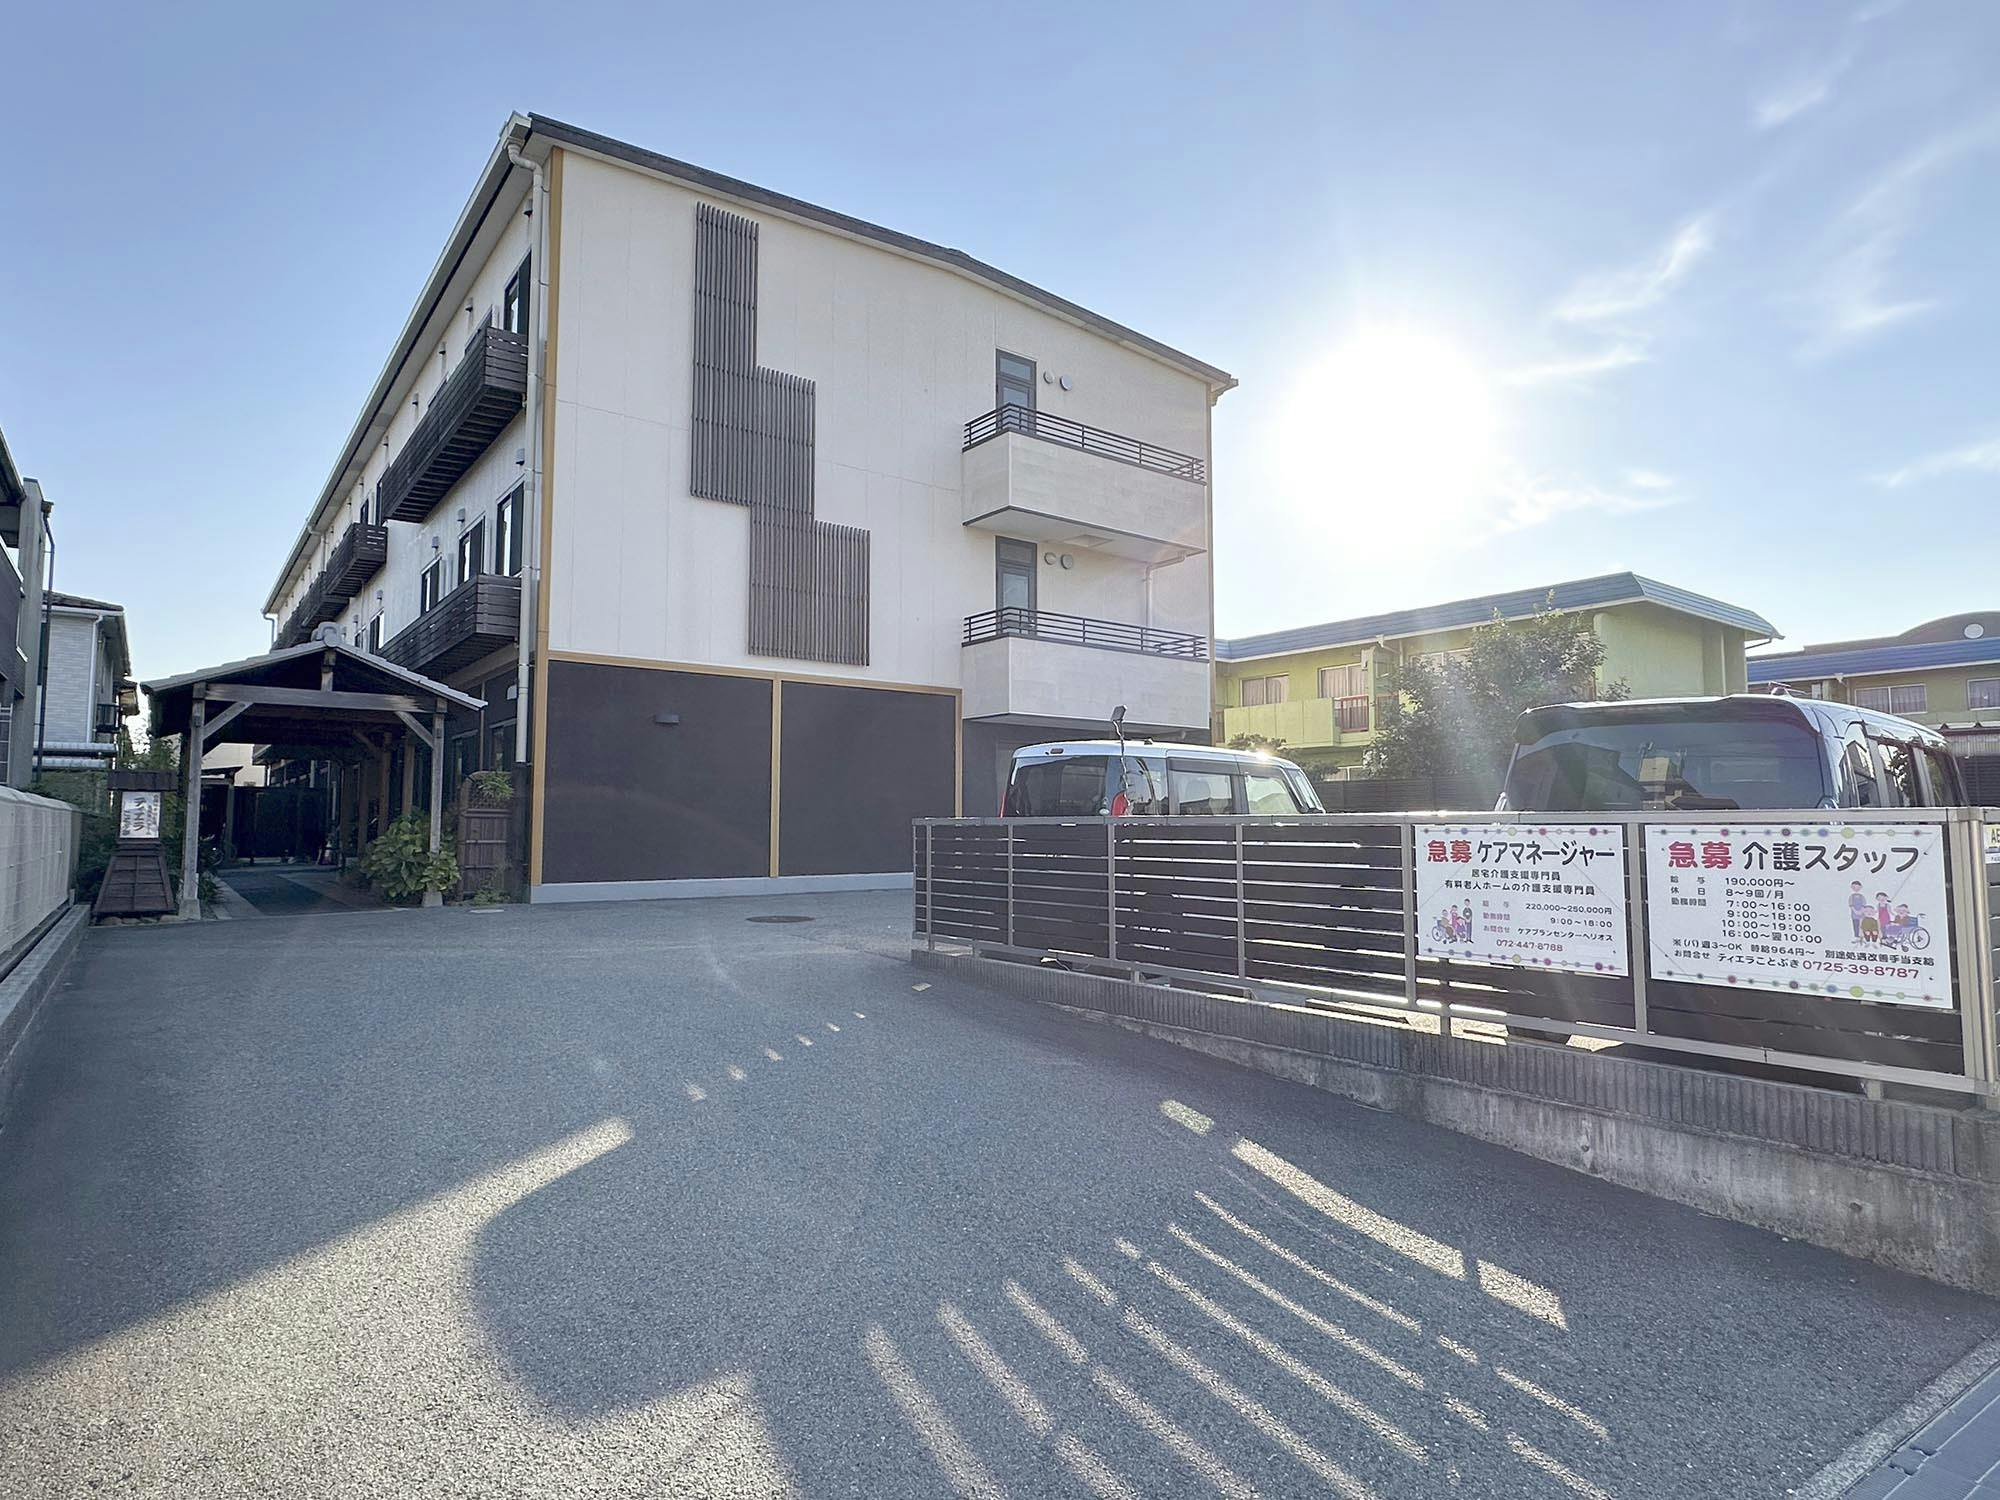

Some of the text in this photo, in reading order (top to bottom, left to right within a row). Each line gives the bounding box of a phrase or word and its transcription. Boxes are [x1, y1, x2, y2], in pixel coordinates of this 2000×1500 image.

[1427, 839, 1615, 867] 急募 ケアマネージャー
[1668, 840, 1919, 874] 急募 介護スタッフ
[1471, 868, 1561, 881] 居宅介護支援専門員
[1444, 879, 1595, 896] 有料老人ホームの介護支援専門員
[1674, 949, 1919, 980] お問合せ ティエラことぶき 0725-39-8787
[1824, 949, 1935, 967] 別途処遇改善手当支給
